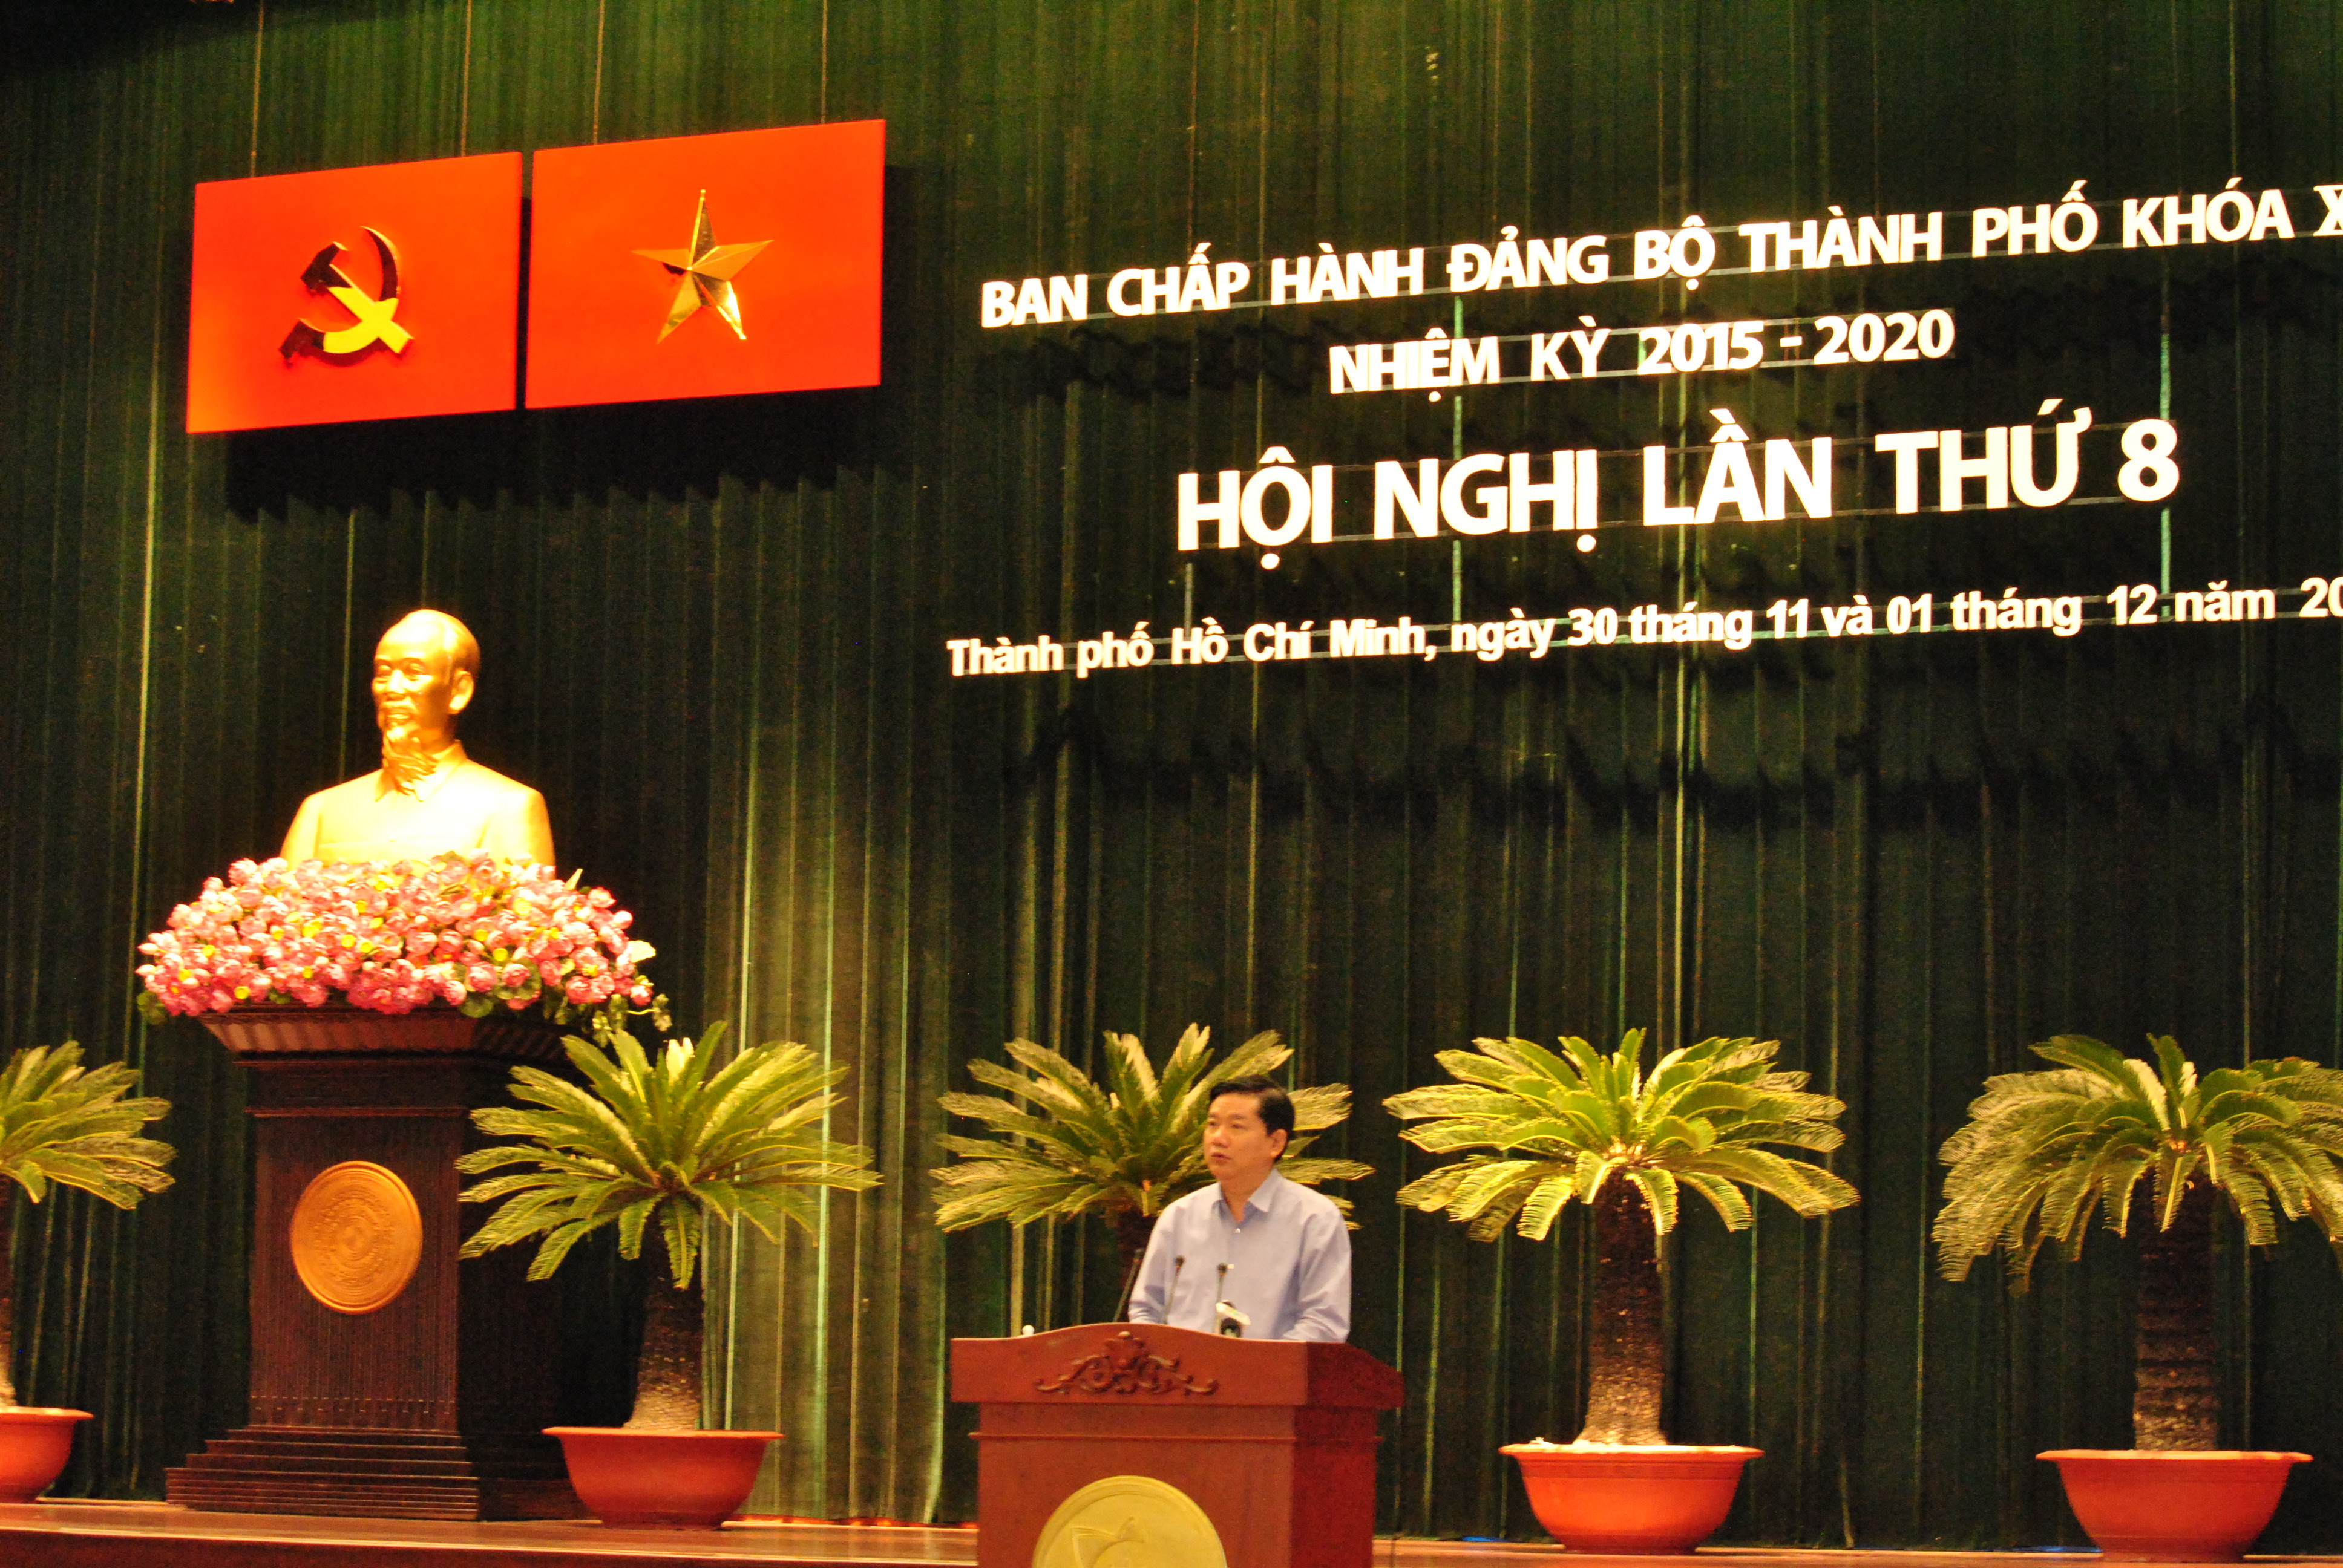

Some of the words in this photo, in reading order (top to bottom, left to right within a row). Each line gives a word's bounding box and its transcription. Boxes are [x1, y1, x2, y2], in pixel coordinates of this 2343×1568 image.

[981, 274, 1089, 328] BAN
[1107, 241, 1250, 316] CHẤP
[1270, 241, 1425, 305] HÀNH
[1445, 224, 1610, 292] ĐẢNG
[1633, 214, 1717, 290] BỘ
[1738, 206, 1943, 273] THÀNH
[1972, 179, 2099, 257] PHỐ
[2122, 177, 2295, 248] KHÓA
[1329, 326, 1501, 402] NHIỆM
[1530, 315, 1613, 381] KỲ
[1636, 319, 1766, 376] 2015
[1813, 309, 1955, 365] 2020
[1178, 445, 1334, 570] HỘI
[1374, 449, 1598, 553] NGHỊ
[1643, 408, 1832, 526] LẦN
[1875, 398, 2093, 514] THỨ
[2117, 419, 2180, 501] 8
[946, 635, 1063, 676] Thành
[1077, 621, 1154, 678] phố
[1172, 616, 1229, 664] Hồ
[1244, 620, 1312, 661] Chí
[1329, 616, 1438, 661] Minh,
[1450, 607, 1558, 661] ngày
[1567, 607, 1619, 647] 30
[1628, 601, 1754, 650] tháng
[1766, 598, 1809, 639] 11
[1820, 594, 1874, 637] và
[1886, 593, 1932, 634] 01
[1950, 587, 2083, 637] tháng
[2106, 583, 2158, 626] 12
[2176, 580, 2275, 622] năm
